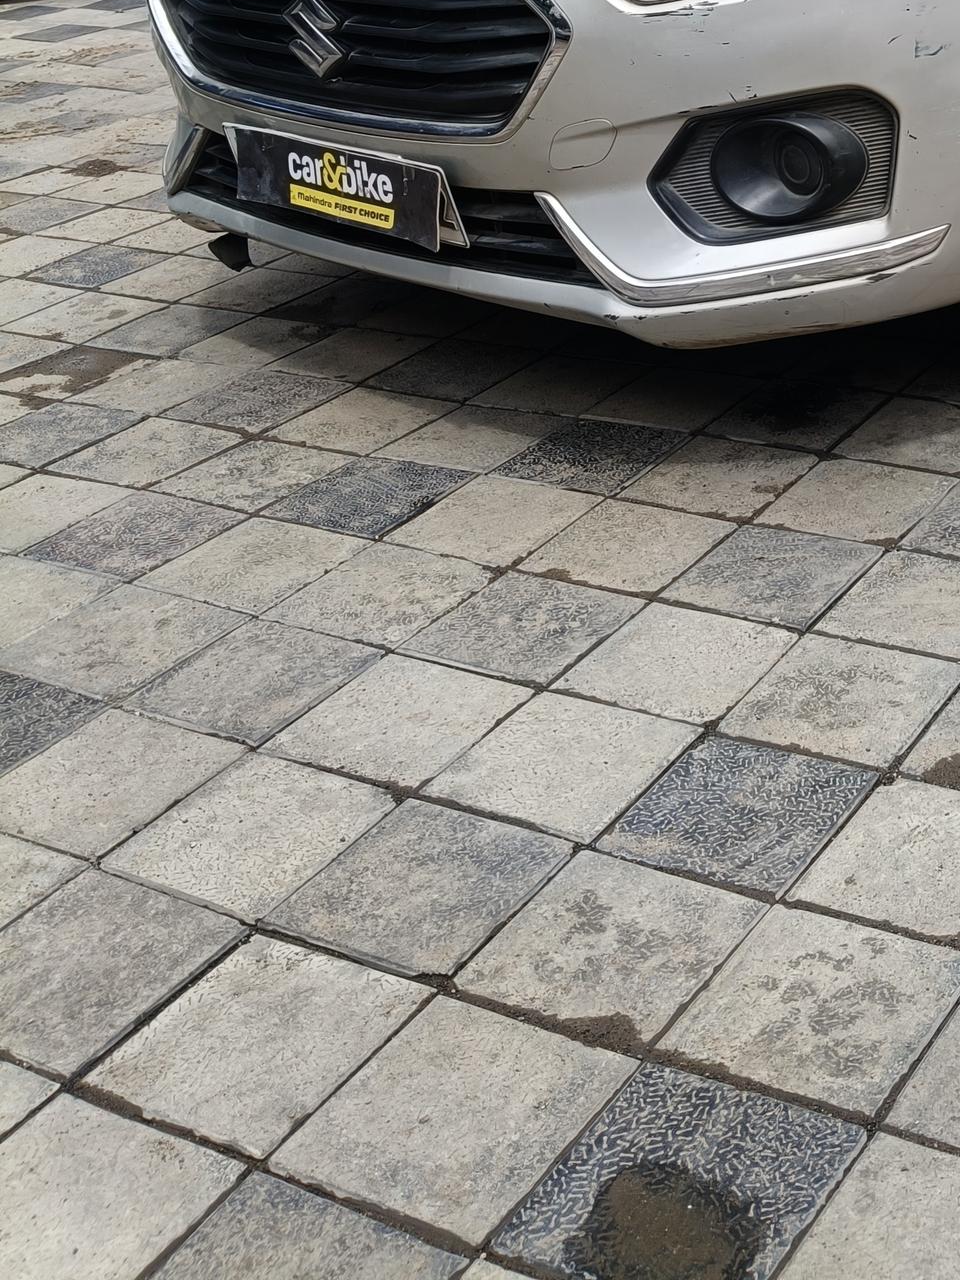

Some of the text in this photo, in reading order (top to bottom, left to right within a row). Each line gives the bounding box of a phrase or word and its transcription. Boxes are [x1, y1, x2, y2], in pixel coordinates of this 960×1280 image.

[288, 152, 394, 204] car&bike
[297, 192, 390, 223] Mahindra FIRST CHOICE
